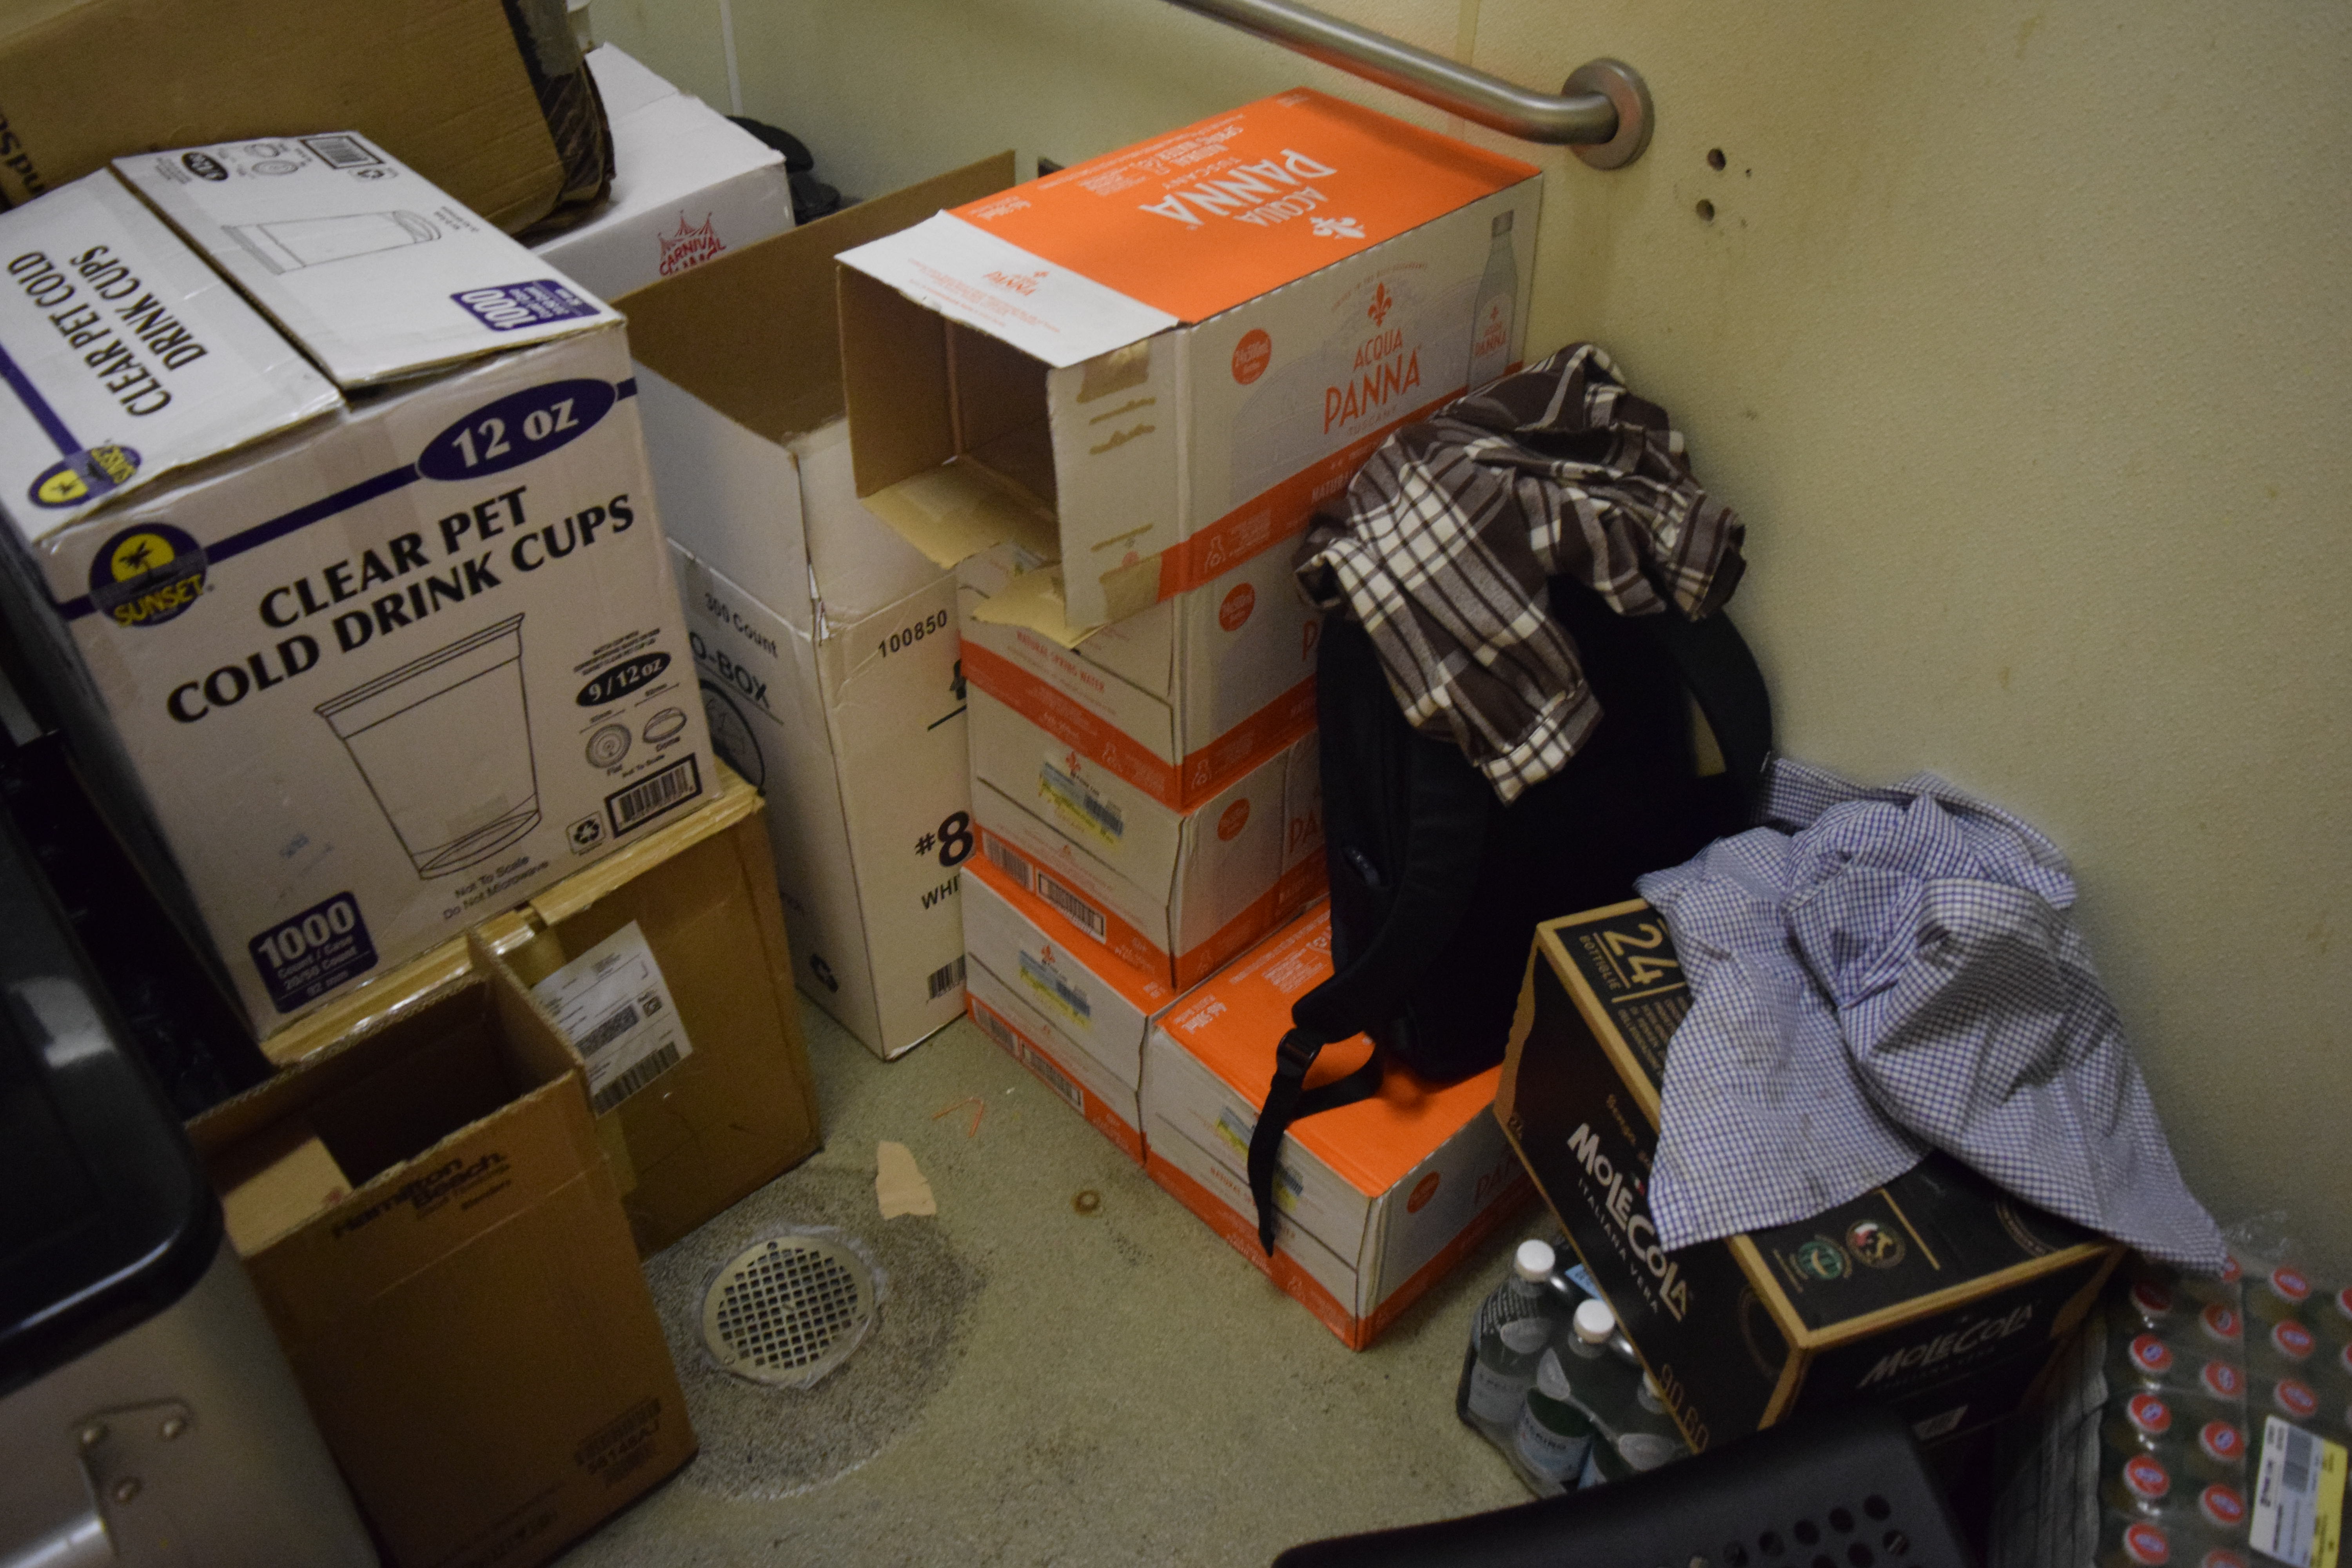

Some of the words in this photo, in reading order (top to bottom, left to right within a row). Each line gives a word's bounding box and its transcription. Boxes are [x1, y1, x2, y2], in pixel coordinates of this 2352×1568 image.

[1138, 148, 1338, 226] PANNA
[1232, 186, 1329, 227] ACQUA
[7, 250, 76, 309] COLD
[69, 244, 142, 302] CUPS
[659, 236, 726, 277] CARNIVAL
[47, 302, 113, 351] PET
[115, 291, 210, 371] DRINK
[461, 289, 538, 329] 1000
[83, 338, 174, 417] CLEAR
[1354, 328, 1403, 372] ACQUA
[1324, 350, 1420, 434] PANNA
[451, 417, 512, 468] 12
[259, 532, 432, 628] CLEAR
[437, 485, 528, 555] PET
[113, 573, 206, 627] SUNSET
[166, 633, 320, 723] COLD
[330, 550, 502, 653] DRINK
[510, 493, 635, 572] CUPS
[878, 610, 948, 658] 100850
[689, 631, 769, 709] O-BOX
[444, 904, 461, 920] Do
[464, 890, 485, 906] Not
[455, 882, 476, 897] Not
[475, 872, 494, 887] To
[495, 856, 530, 879] Scale
[257, 901, 355, 969] 1000
[321, 947, 358, 969] Count
[1603, 923, 1682, 984] 24
[277, 956, 315, 978] Count
[331, 1159, 464, 1239] Hamilton
[408, 1152, 507, 1209] Beach
[1578, 1178, 1626, 1265] ITALIANA
[1630, 1261, 1660, 1314] VERA
